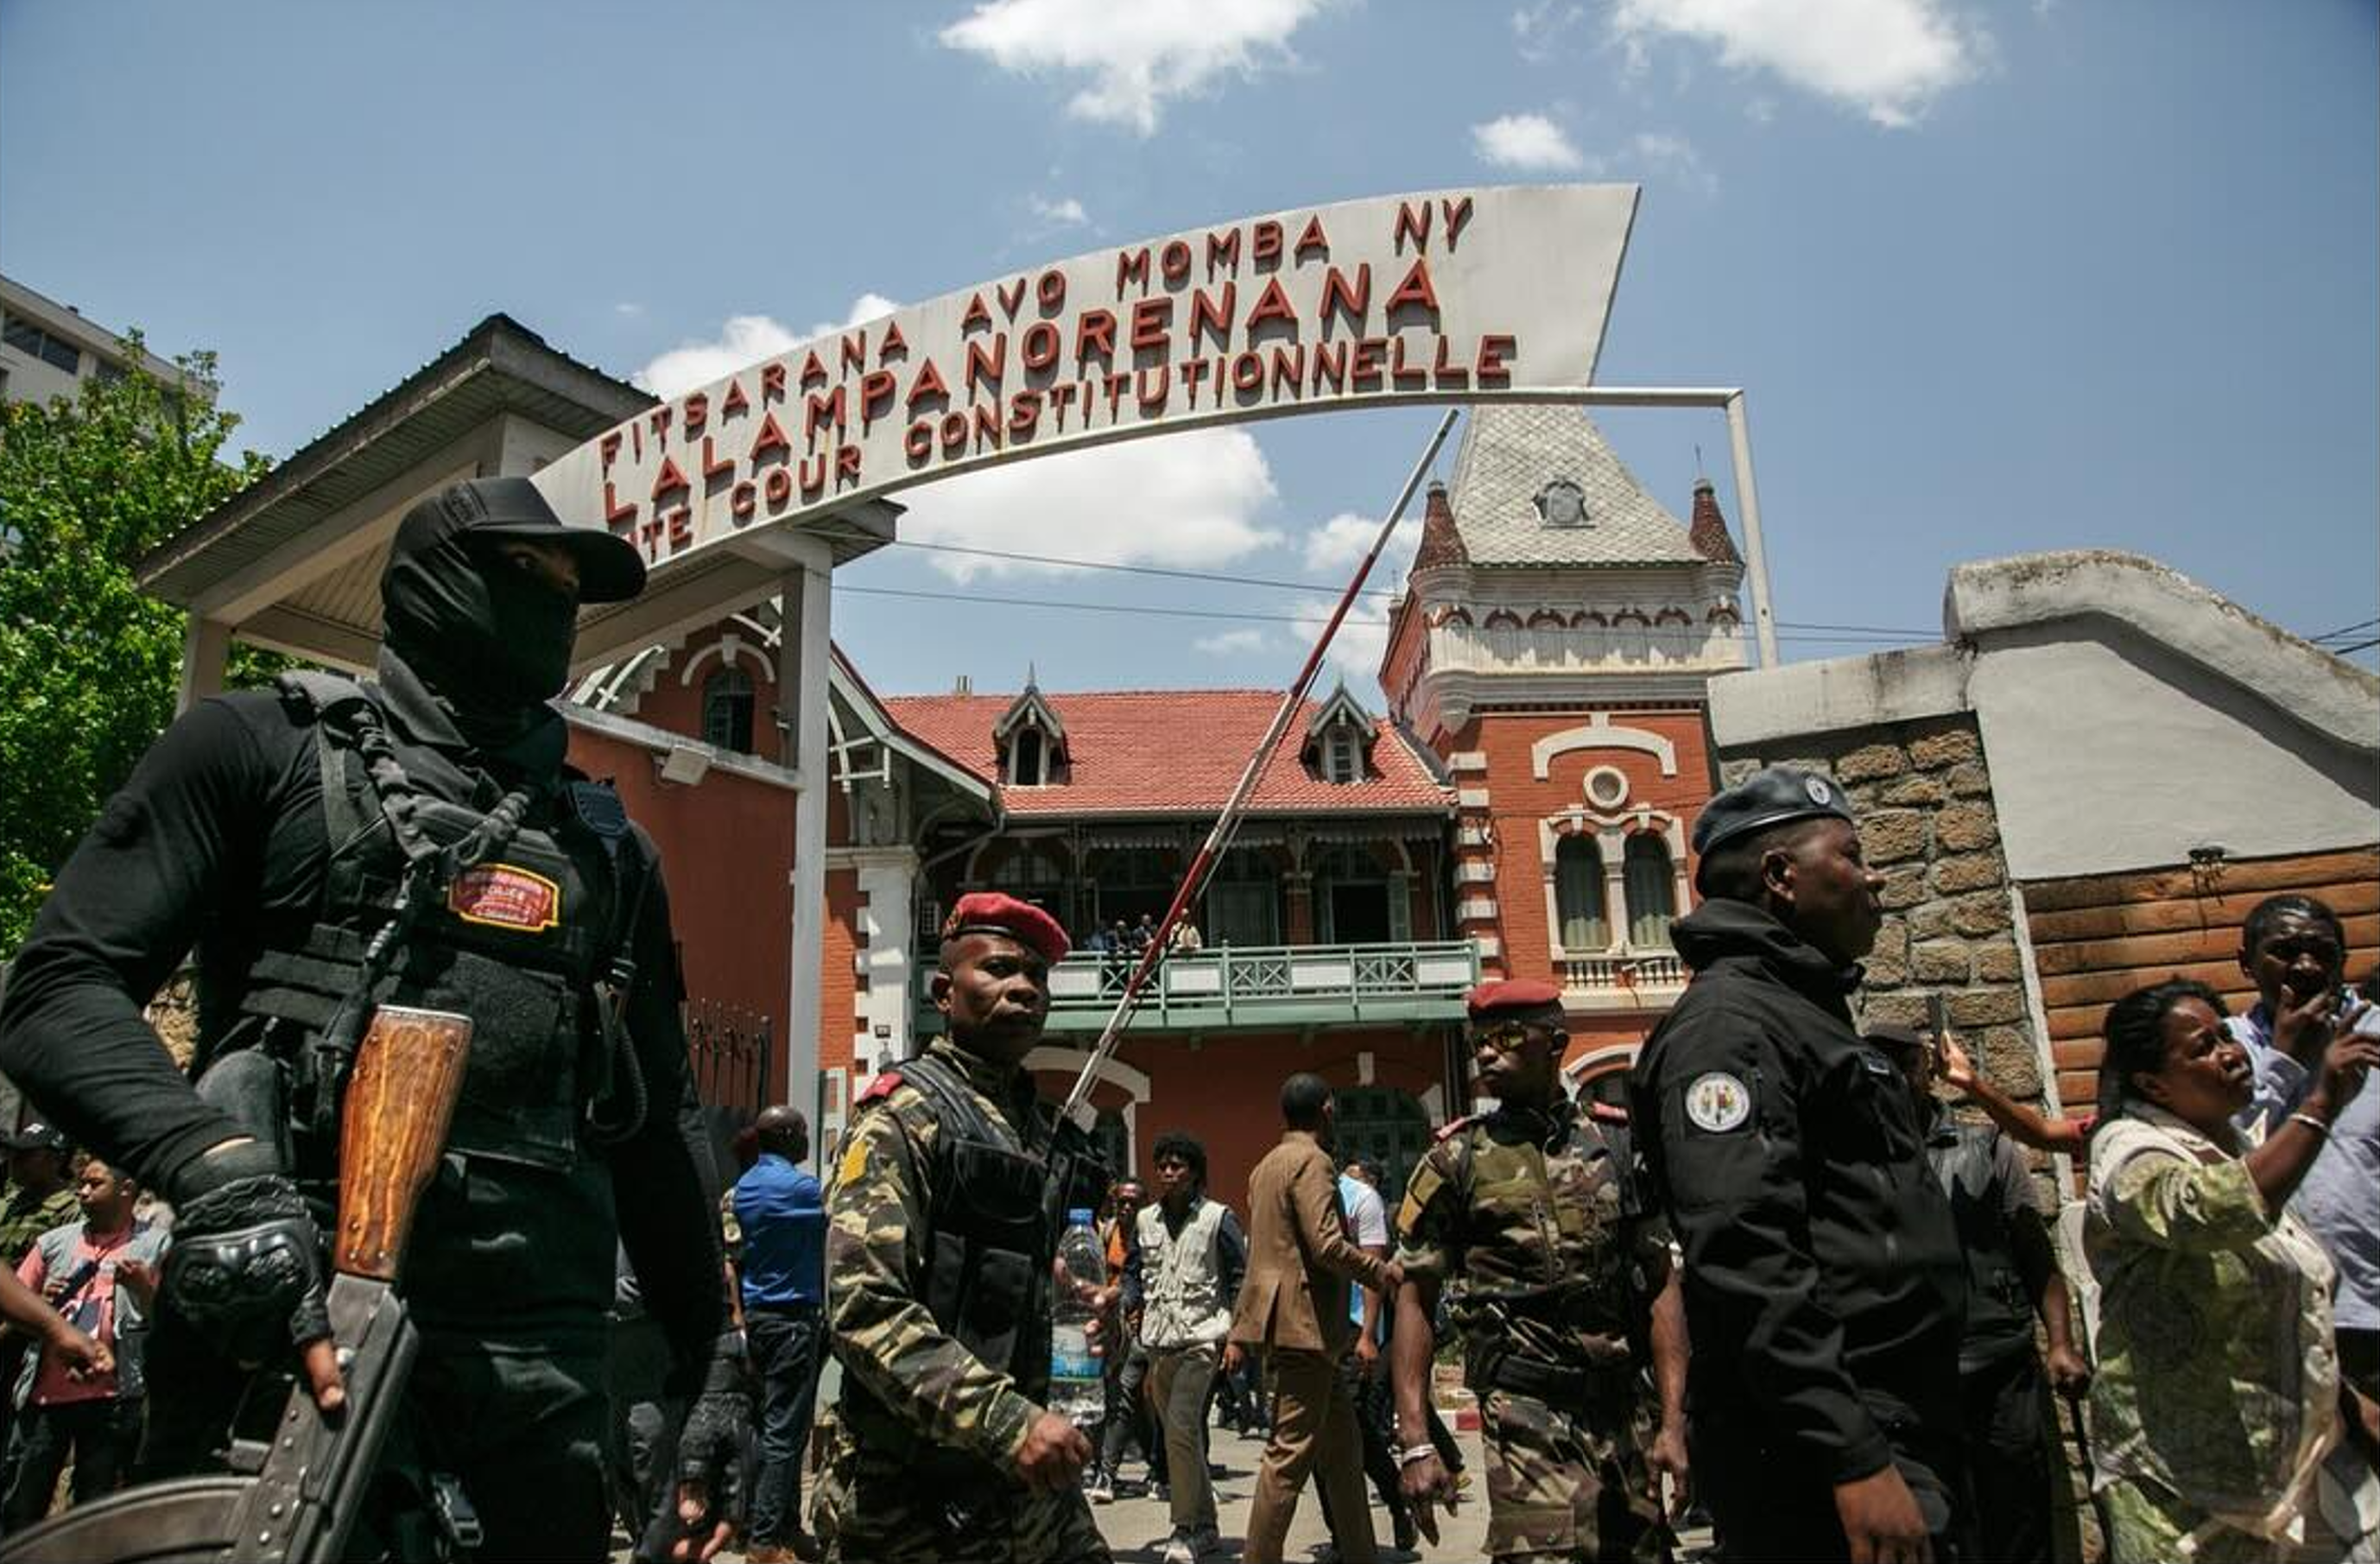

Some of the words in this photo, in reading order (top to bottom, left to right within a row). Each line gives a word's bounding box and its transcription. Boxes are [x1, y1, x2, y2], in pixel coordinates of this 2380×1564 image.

[603, 320, 909, 473] FITSARANA
[963, 269, 1066, 326] AVO
[1117, 214, 1328, 296] MOMBA
[1394, 196, 1473, 252] NY
[605, 258, 1440, 529] LALAMPANORENANA
[731, 444, 861, 522] COUR
[903, 333, 1516, 468] CONSTITUTIONNELLE
